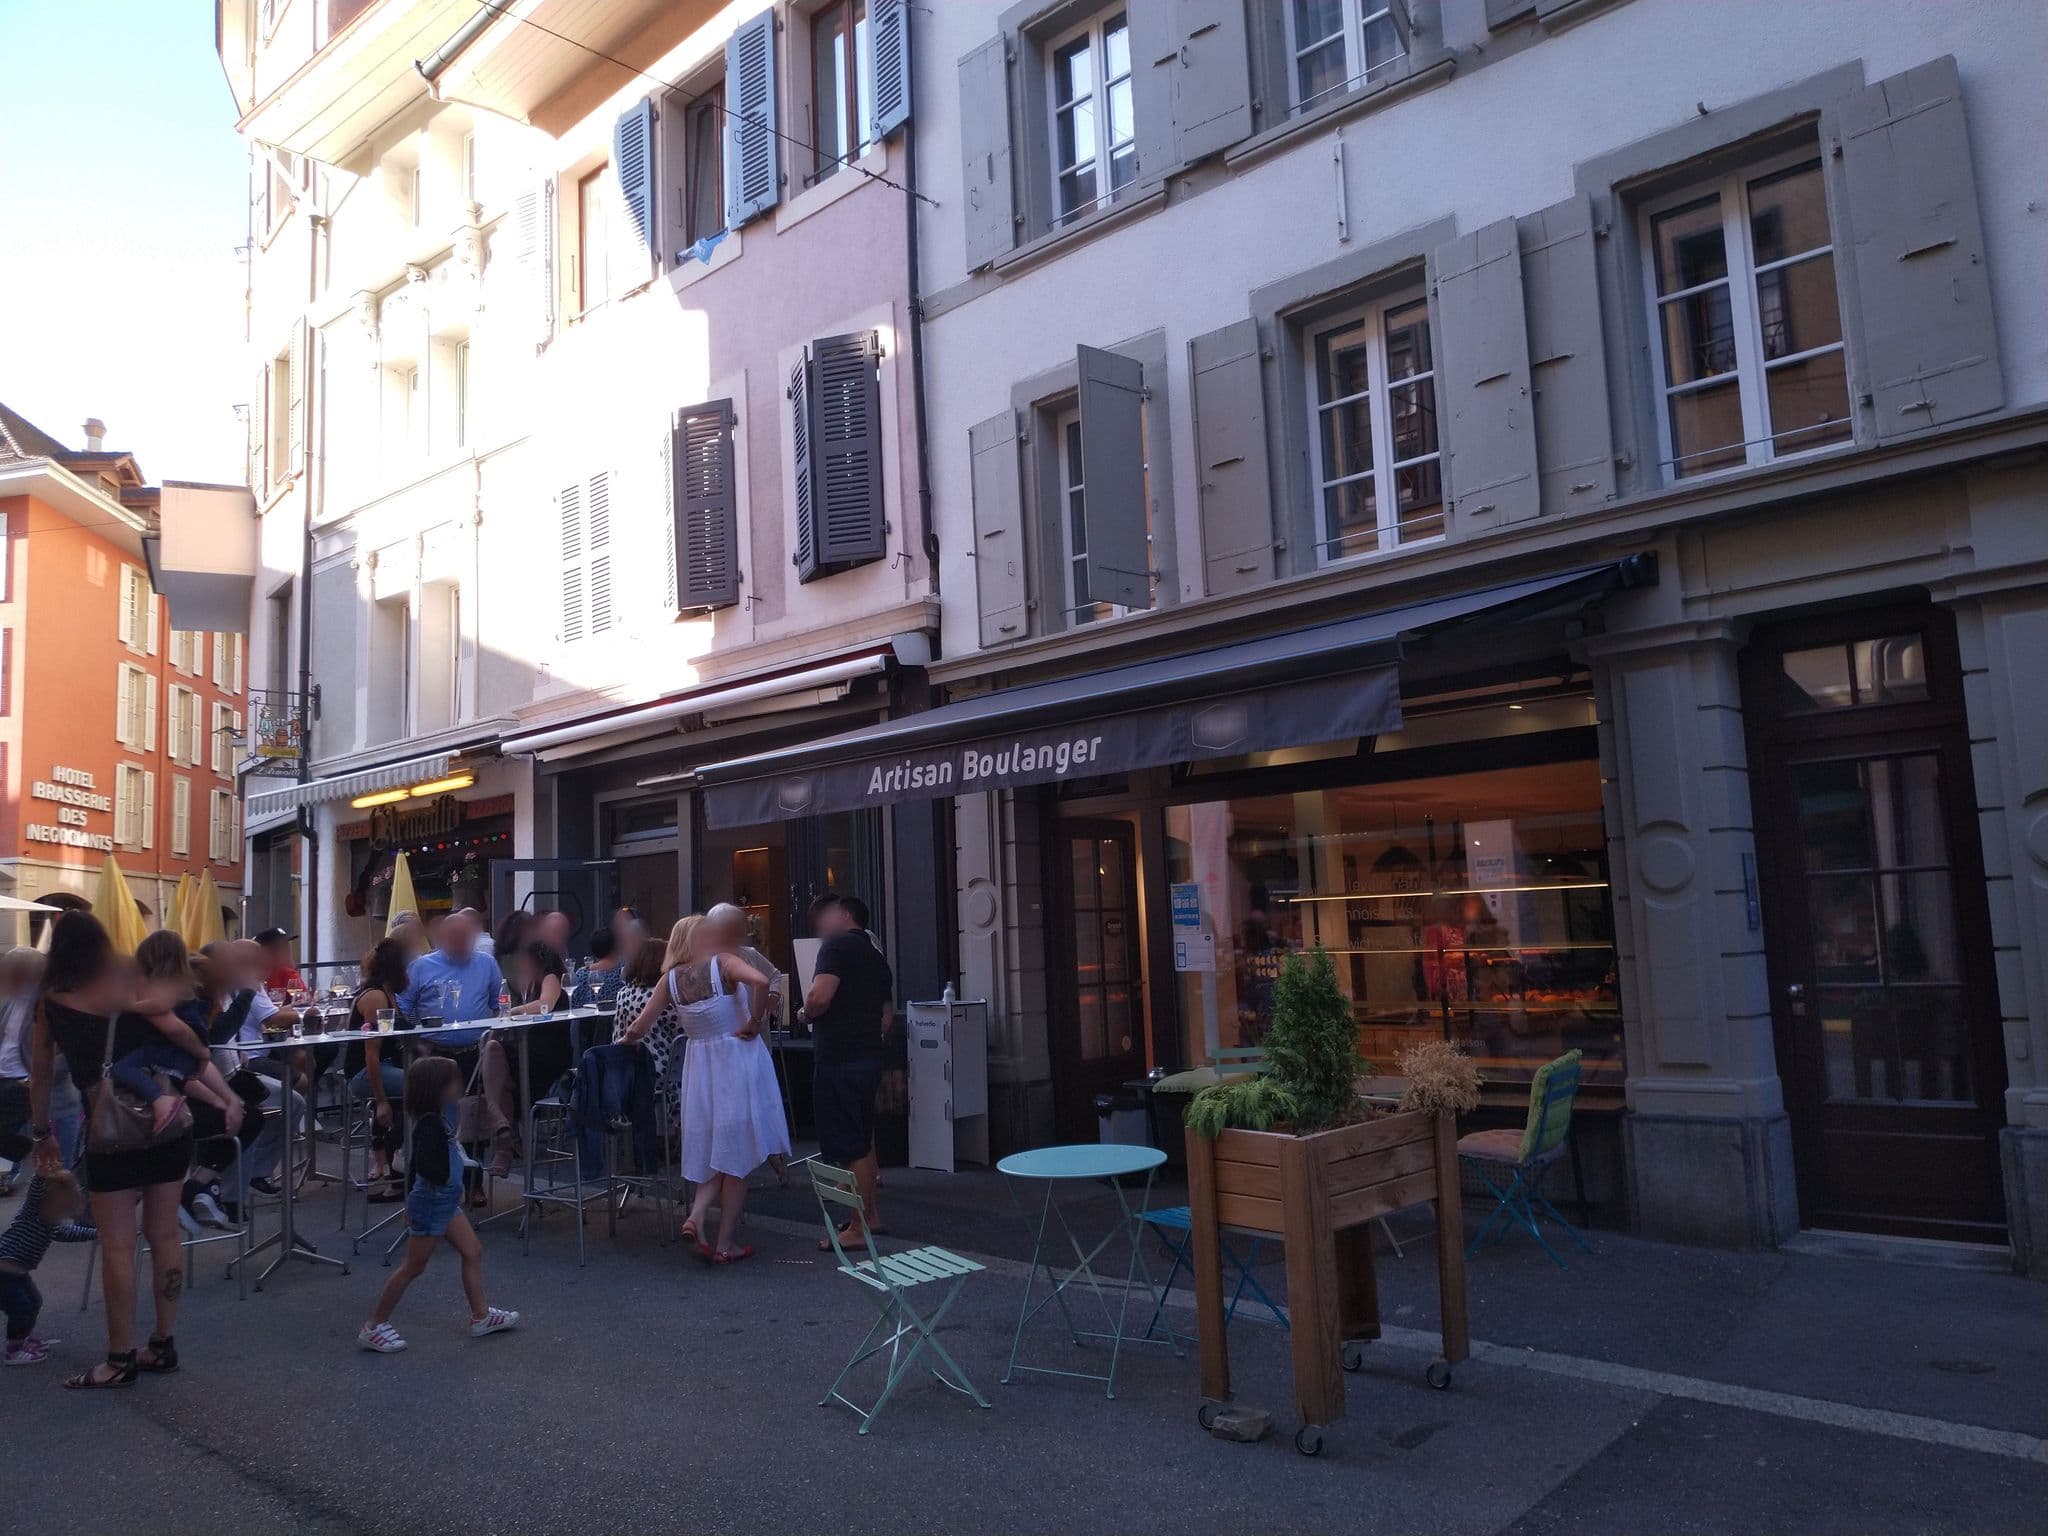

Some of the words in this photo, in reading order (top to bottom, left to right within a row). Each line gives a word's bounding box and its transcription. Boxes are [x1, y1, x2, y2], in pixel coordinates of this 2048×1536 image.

[52, 765, 96, 788] HOTEL
[867, 760, 952, 794] Artisan
[963, 737, 1102, 780] Boulanger
[32, 781, 112, 812] BRASSERIE
[58, 807, 88, 826] DES
[26, 824, 113, 851] NEGOCIANTS
